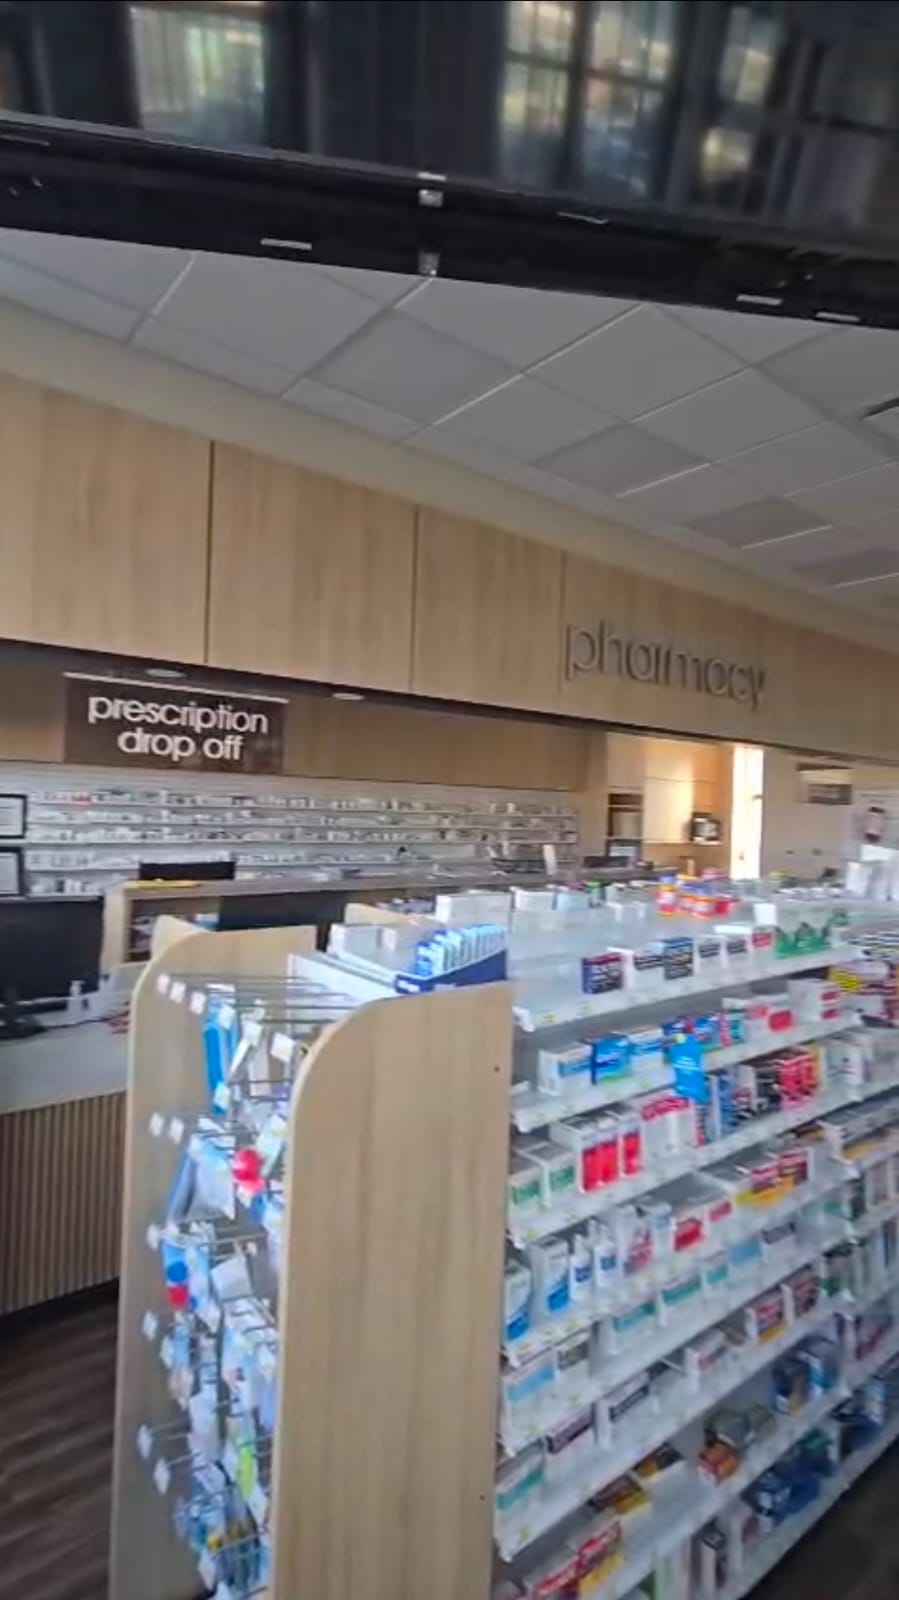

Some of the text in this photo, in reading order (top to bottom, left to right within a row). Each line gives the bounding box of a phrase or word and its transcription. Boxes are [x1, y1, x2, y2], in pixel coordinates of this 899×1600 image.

[565, 619, 766, 711] pharmacy
[88, 695, 268, 734] prescription
[117, 727, 244, 762] drop off
